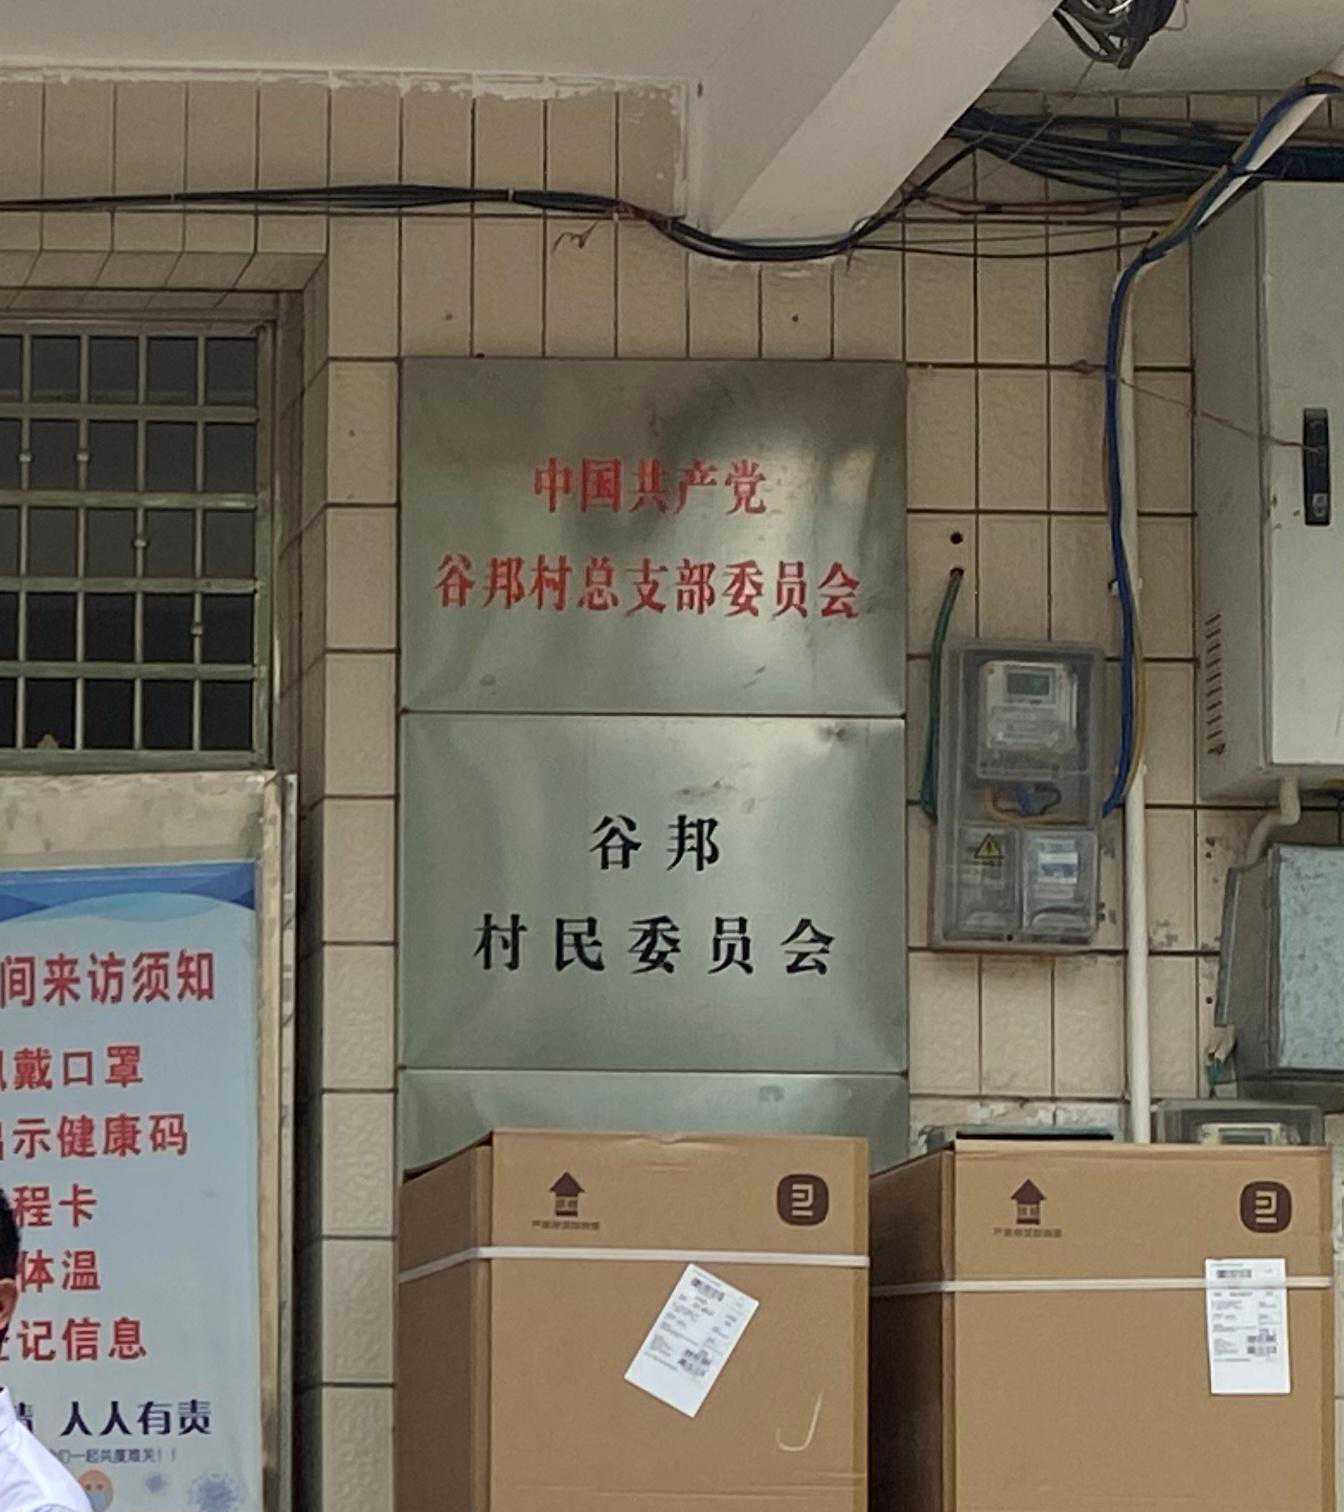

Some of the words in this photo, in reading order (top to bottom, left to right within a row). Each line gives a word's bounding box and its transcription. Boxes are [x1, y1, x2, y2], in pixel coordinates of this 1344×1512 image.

[534, 457, 767, 516] 中国共产党
[435, 552, 861, 620] 谷邦村总支部委员会
[590, 814, 722, 872] 谷邦
[473, 914, 835, 975] 村民委员会
[61, 1399, 211, 1436] 人人有责
